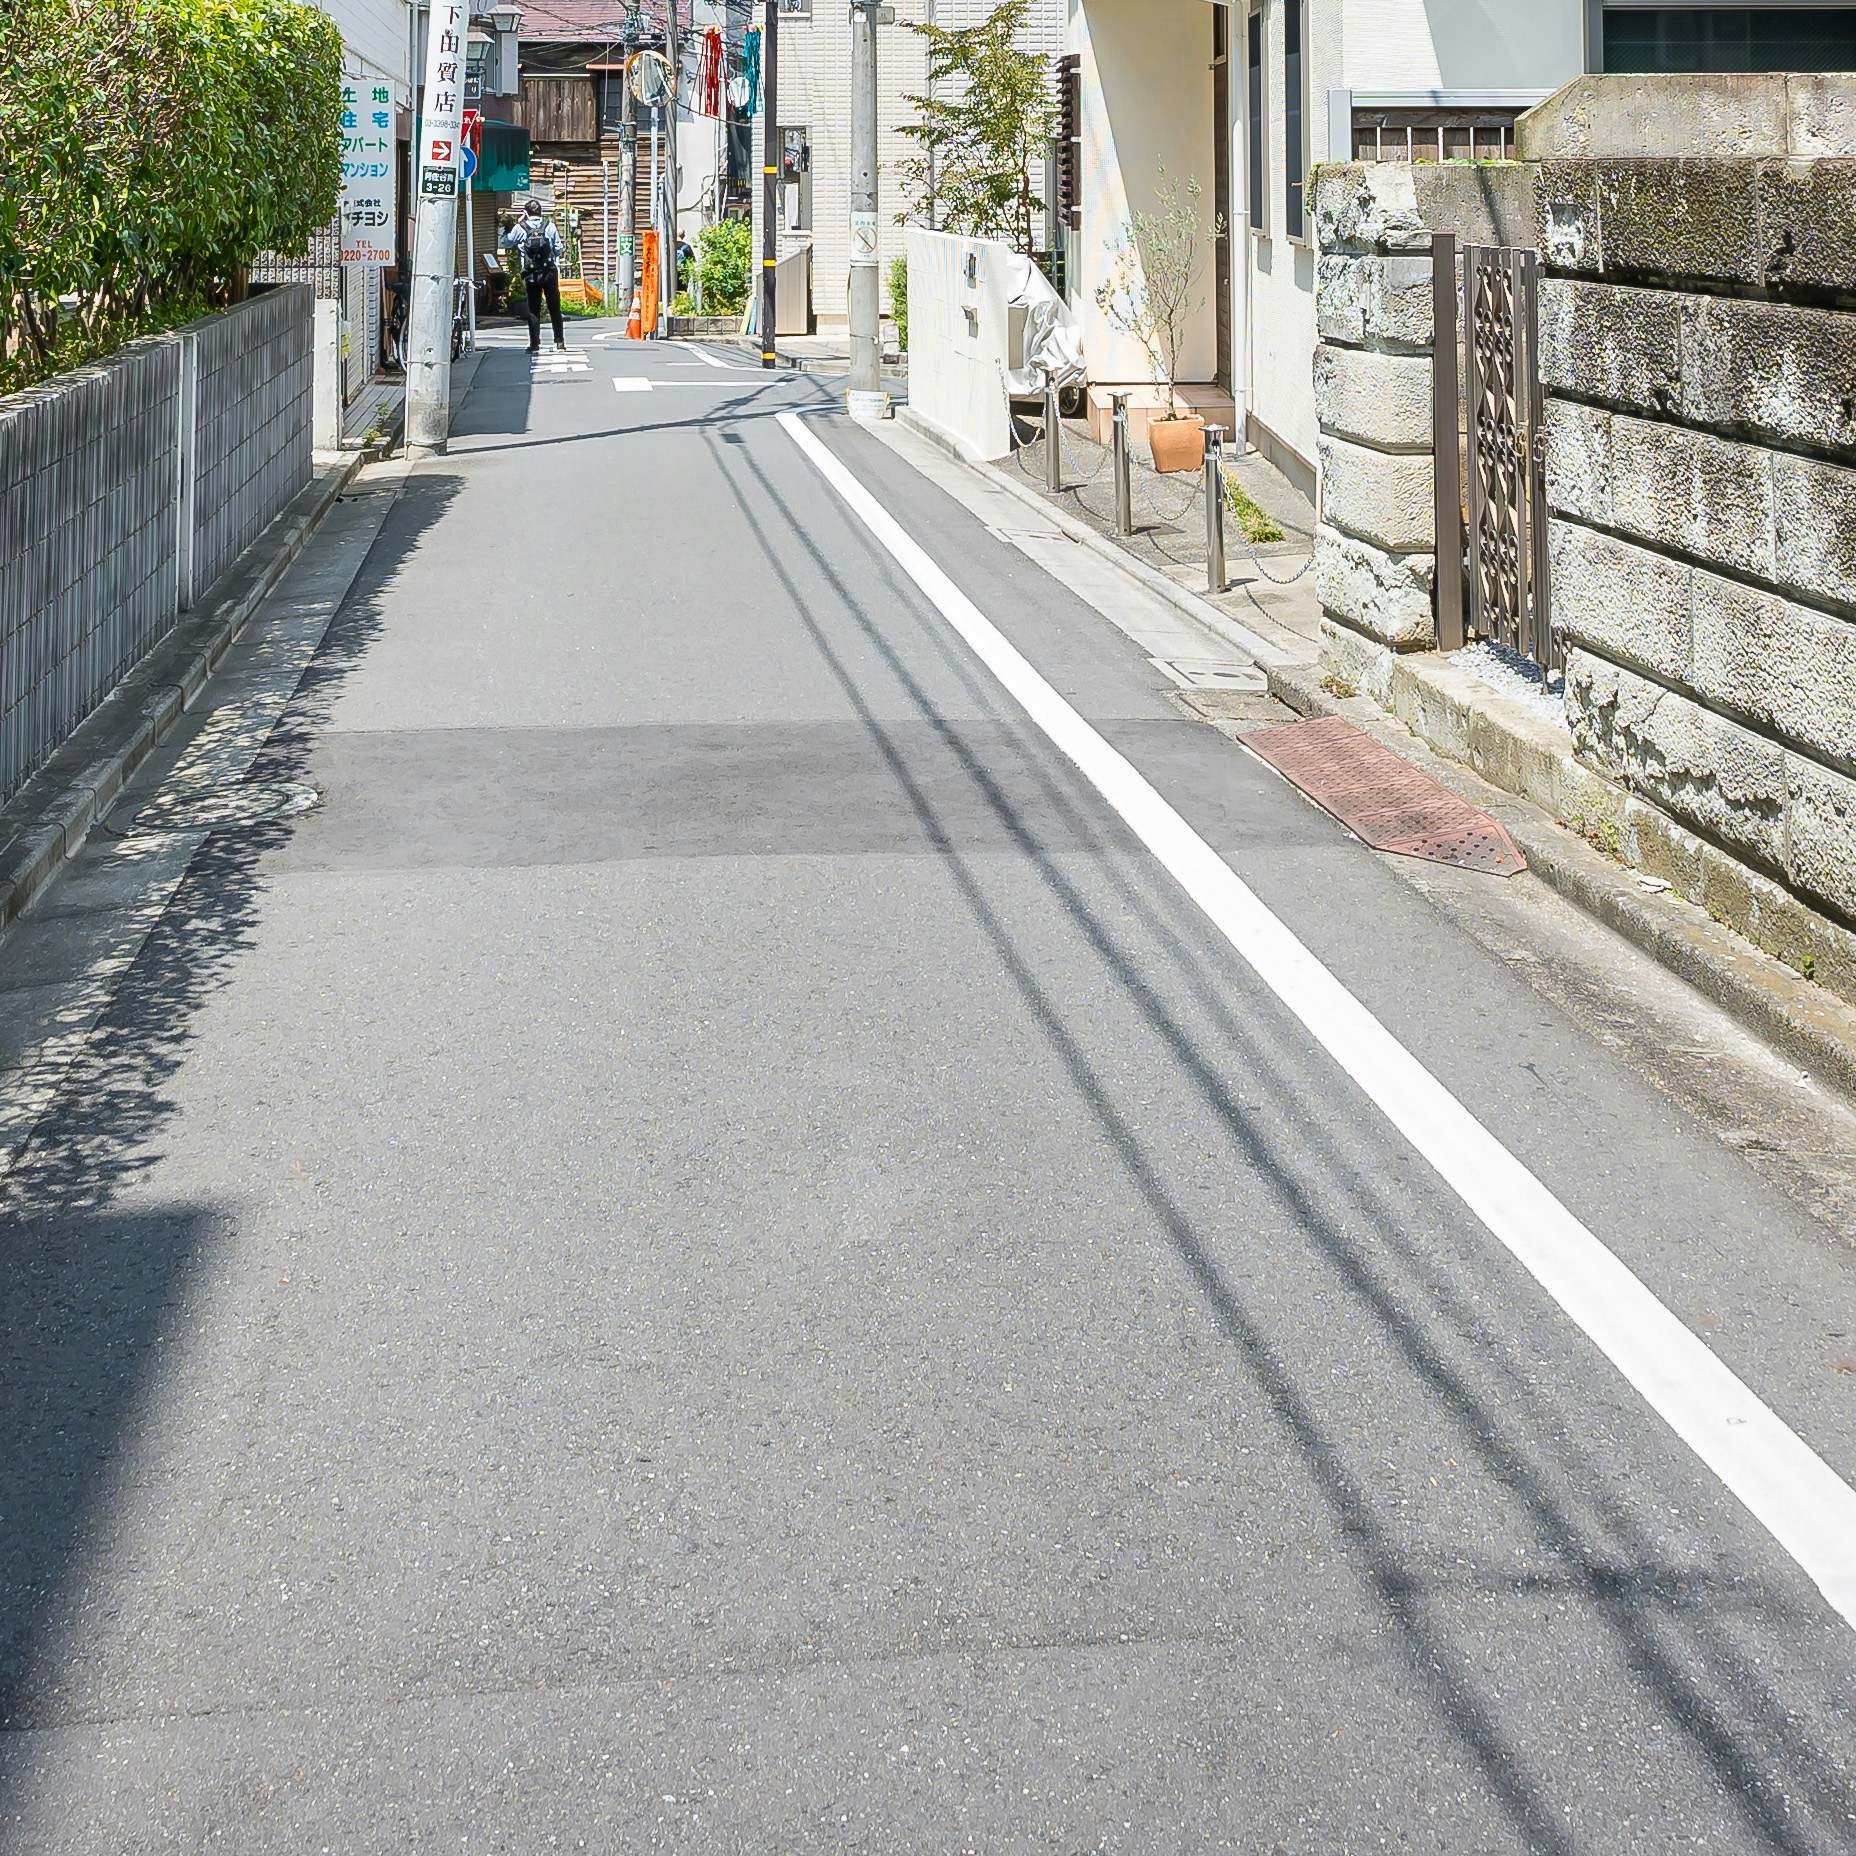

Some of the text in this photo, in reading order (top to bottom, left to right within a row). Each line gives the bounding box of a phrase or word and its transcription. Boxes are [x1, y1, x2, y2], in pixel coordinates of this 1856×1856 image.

[434, 5, 463, 113] 下田質店
[341, 87, 389, 104] 土地
[341, 111, 389, 128] 住宅
[341, 136, 388, 152] アパート
[343, 163, 388, 177] マンション
[425, 182, 452, 193] 3-26
[344, 199, 381, 207] 式会社
[344, 211, 389, 226] チヨシ
[355, 239, 373, 249] TEL
[621, 242, 633, 254] 文
